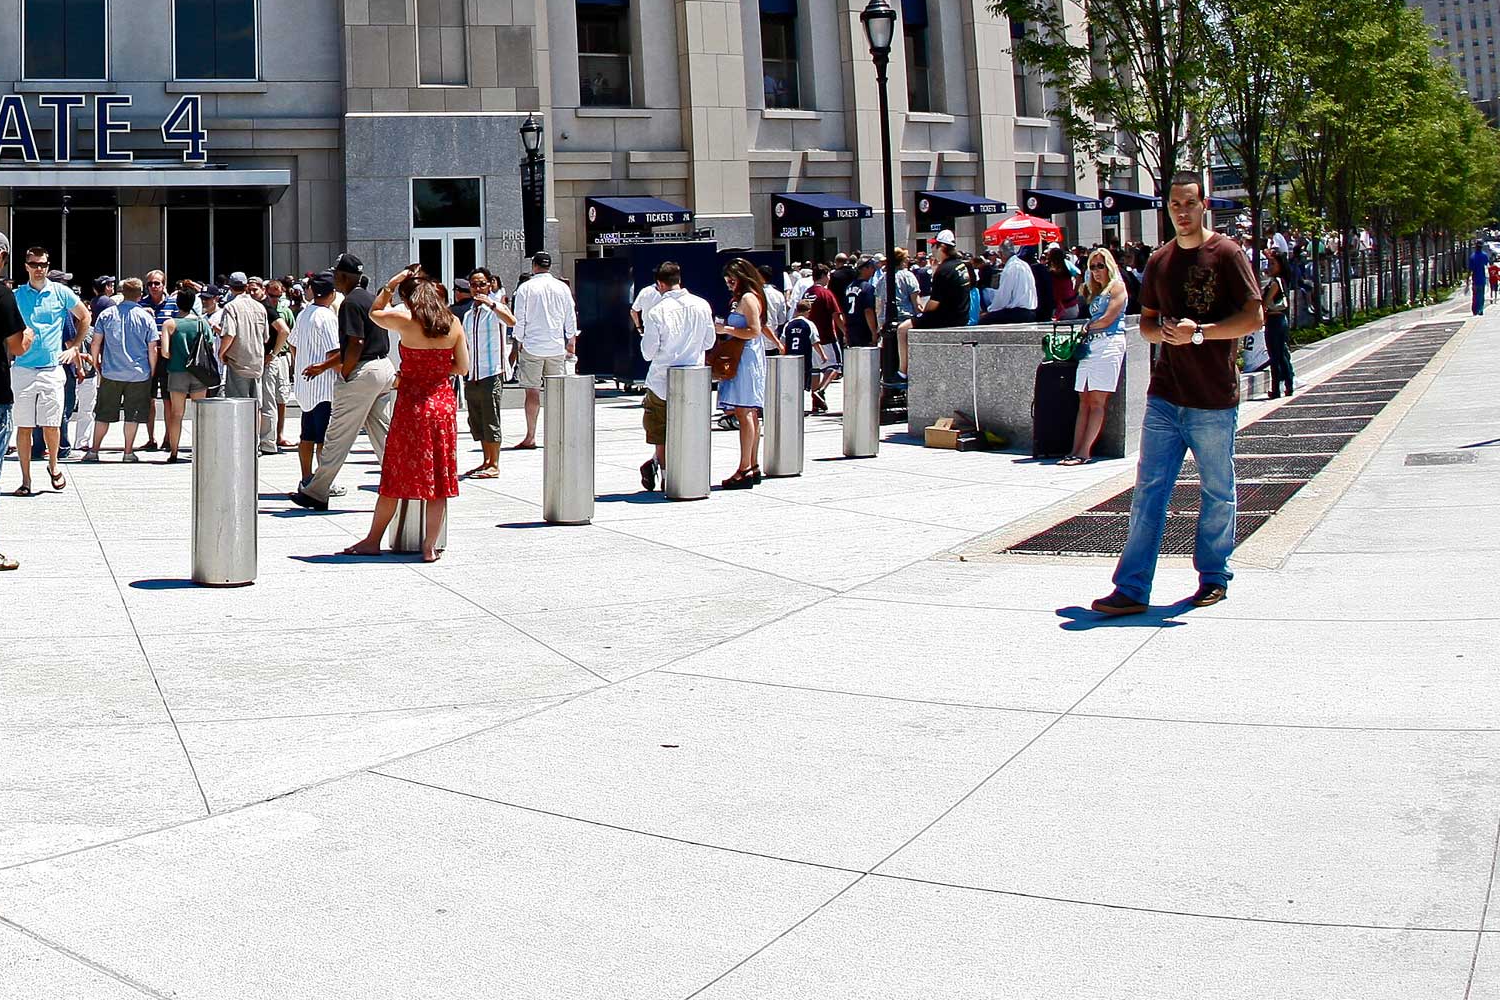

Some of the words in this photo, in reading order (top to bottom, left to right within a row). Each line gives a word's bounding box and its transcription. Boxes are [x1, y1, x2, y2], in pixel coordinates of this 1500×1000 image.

[160, 94, 208, 163] 4
[645, 212, 674, 222] TICKETS
[836, 208, 859, 218] TICKETS
[791, 337, 800, 350] 2
